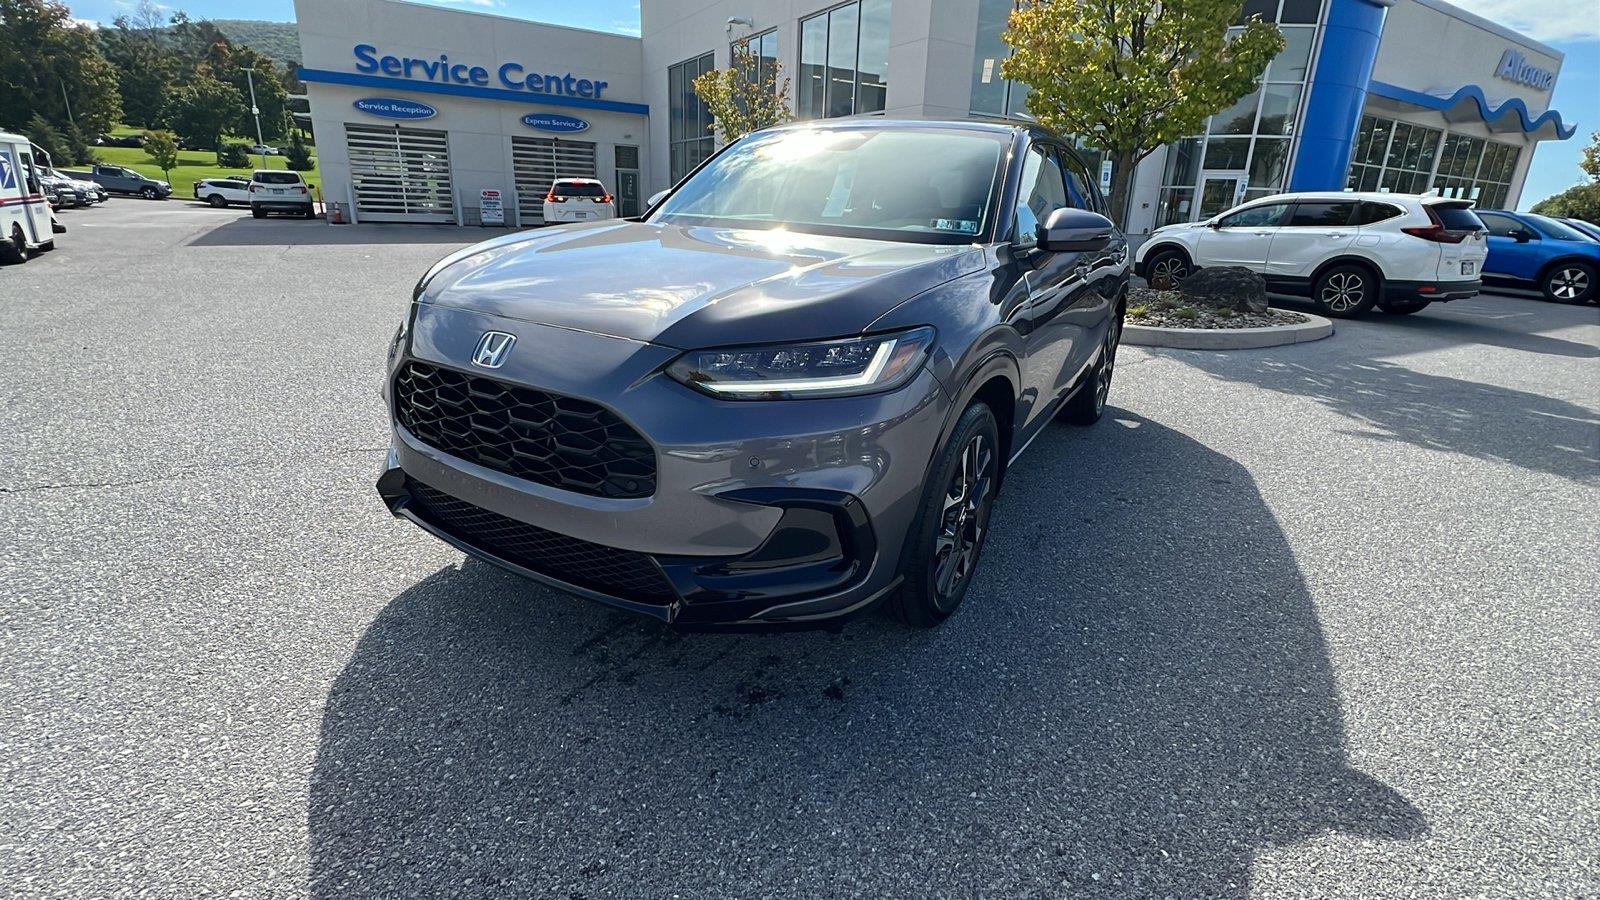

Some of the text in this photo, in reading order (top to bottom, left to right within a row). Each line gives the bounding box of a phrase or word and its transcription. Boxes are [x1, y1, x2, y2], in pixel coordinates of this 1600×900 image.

[353, 43, 608, 98] Service Center
[1494, 49, 1555, 91] Altoona
[358, 101, 432, 115] Service Reception
[525, 117, 576, 128] Express Service
